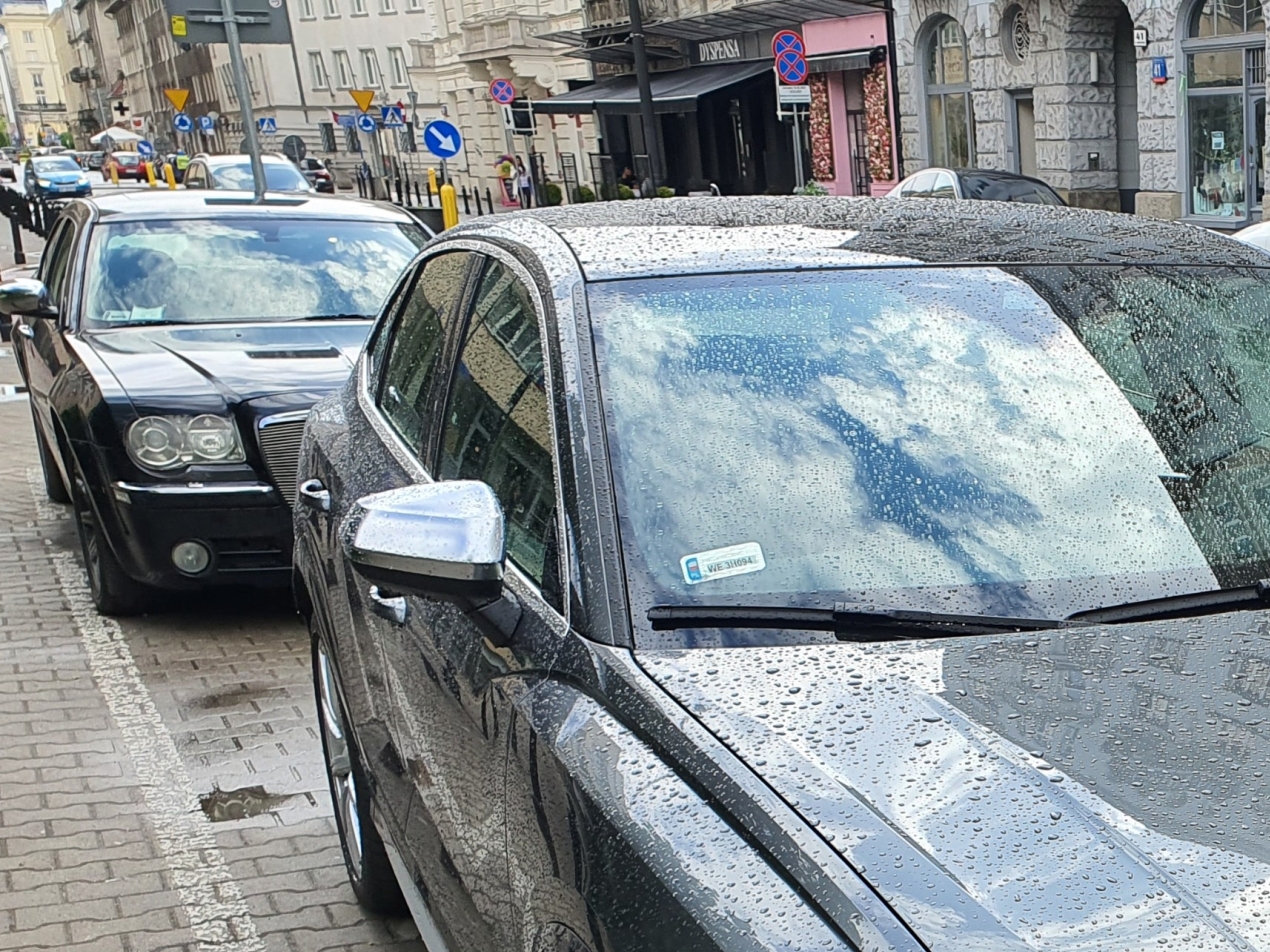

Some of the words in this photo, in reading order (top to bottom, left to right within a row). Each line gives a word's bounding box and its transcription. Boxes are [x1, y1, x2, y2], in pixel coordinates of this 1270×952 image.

[1136, 32, 1144, 41] 41
[699, 39, 740, 62] DYSPENSA
[1154, 63, 1164, 77] 41
[707, 563, 723, 573] WE
